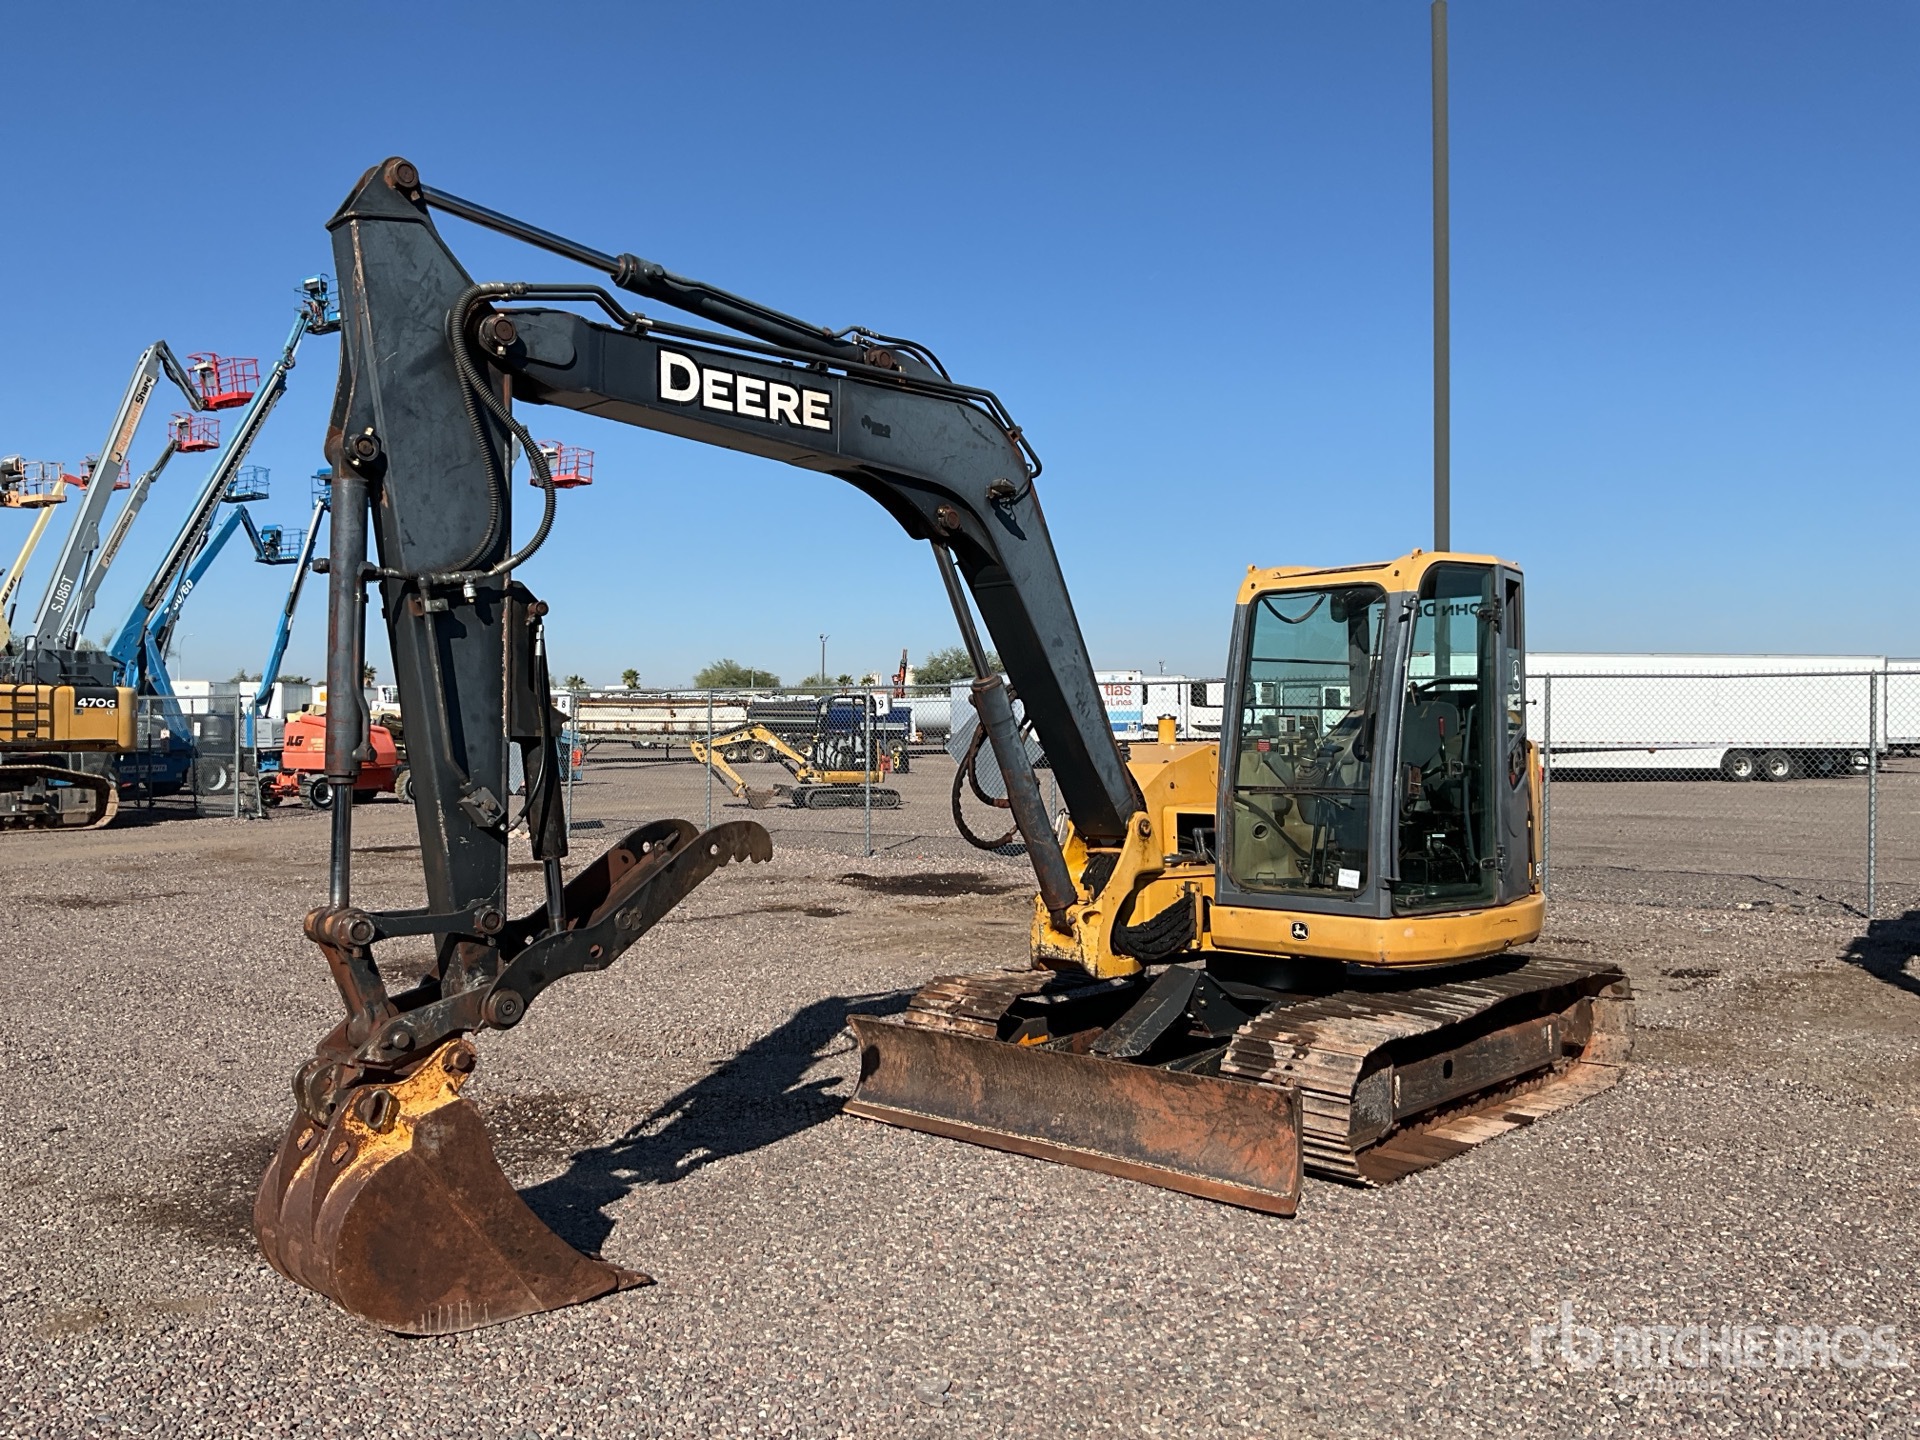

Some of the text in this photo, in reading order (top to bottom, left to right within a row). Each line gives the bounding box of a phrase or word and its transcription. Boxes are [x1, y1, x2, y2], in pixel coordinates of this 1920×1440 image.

[660, 349, 831, 431] DEERE
[50, 574, 74, 613] SJ86T
[1103, 683, 1132, 696] tlas
[77, 697, 116, 708] 470G
[561, 700, 567, 708] 8
[878, 699, 884, 709] 9
[286, 735, 305, 746] JLG
[893, 756, 900, 769] 9
